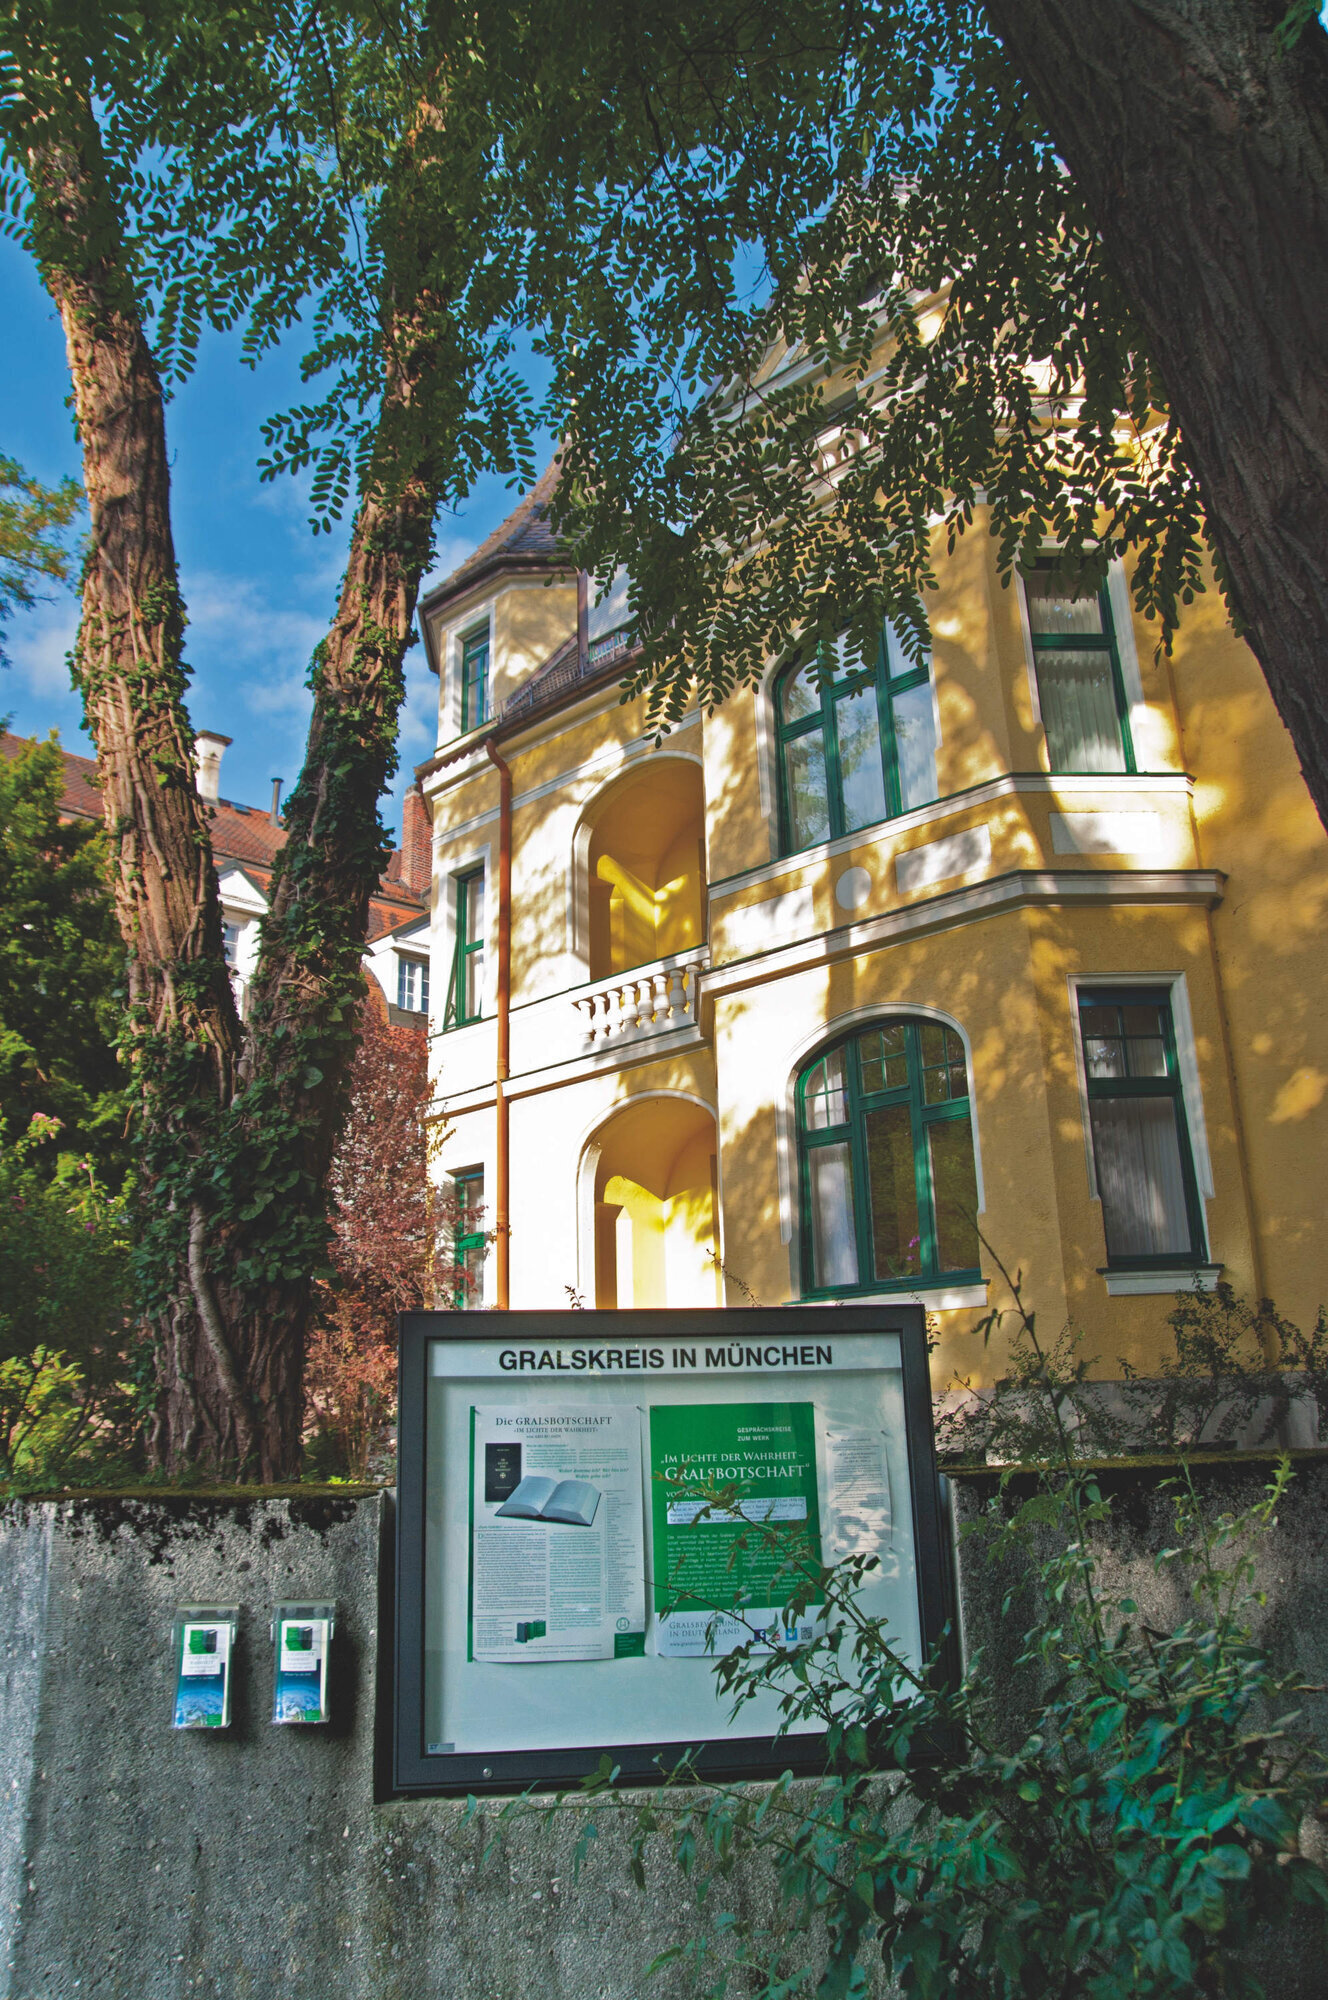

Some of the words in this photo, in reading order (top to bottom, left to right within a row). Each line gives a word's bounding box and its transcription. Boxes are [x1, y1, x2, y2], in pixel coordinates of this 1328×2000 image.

[499, 1348, 665, 1370] GRALSKREIS
[672, 1348, 697, 1368] IN
[706, 1342, 833, 1368] MÜNCHEN
[496, 1417, 513, 1426] Die
[515, 1416, 613, 1425] GRALSBOTSCHAFT
[681, 1453, 718, 1463] LICHTE
[721, 1452, 741, 1462] DER
[743, 1451, 797, 1461] WAHRHEIT
